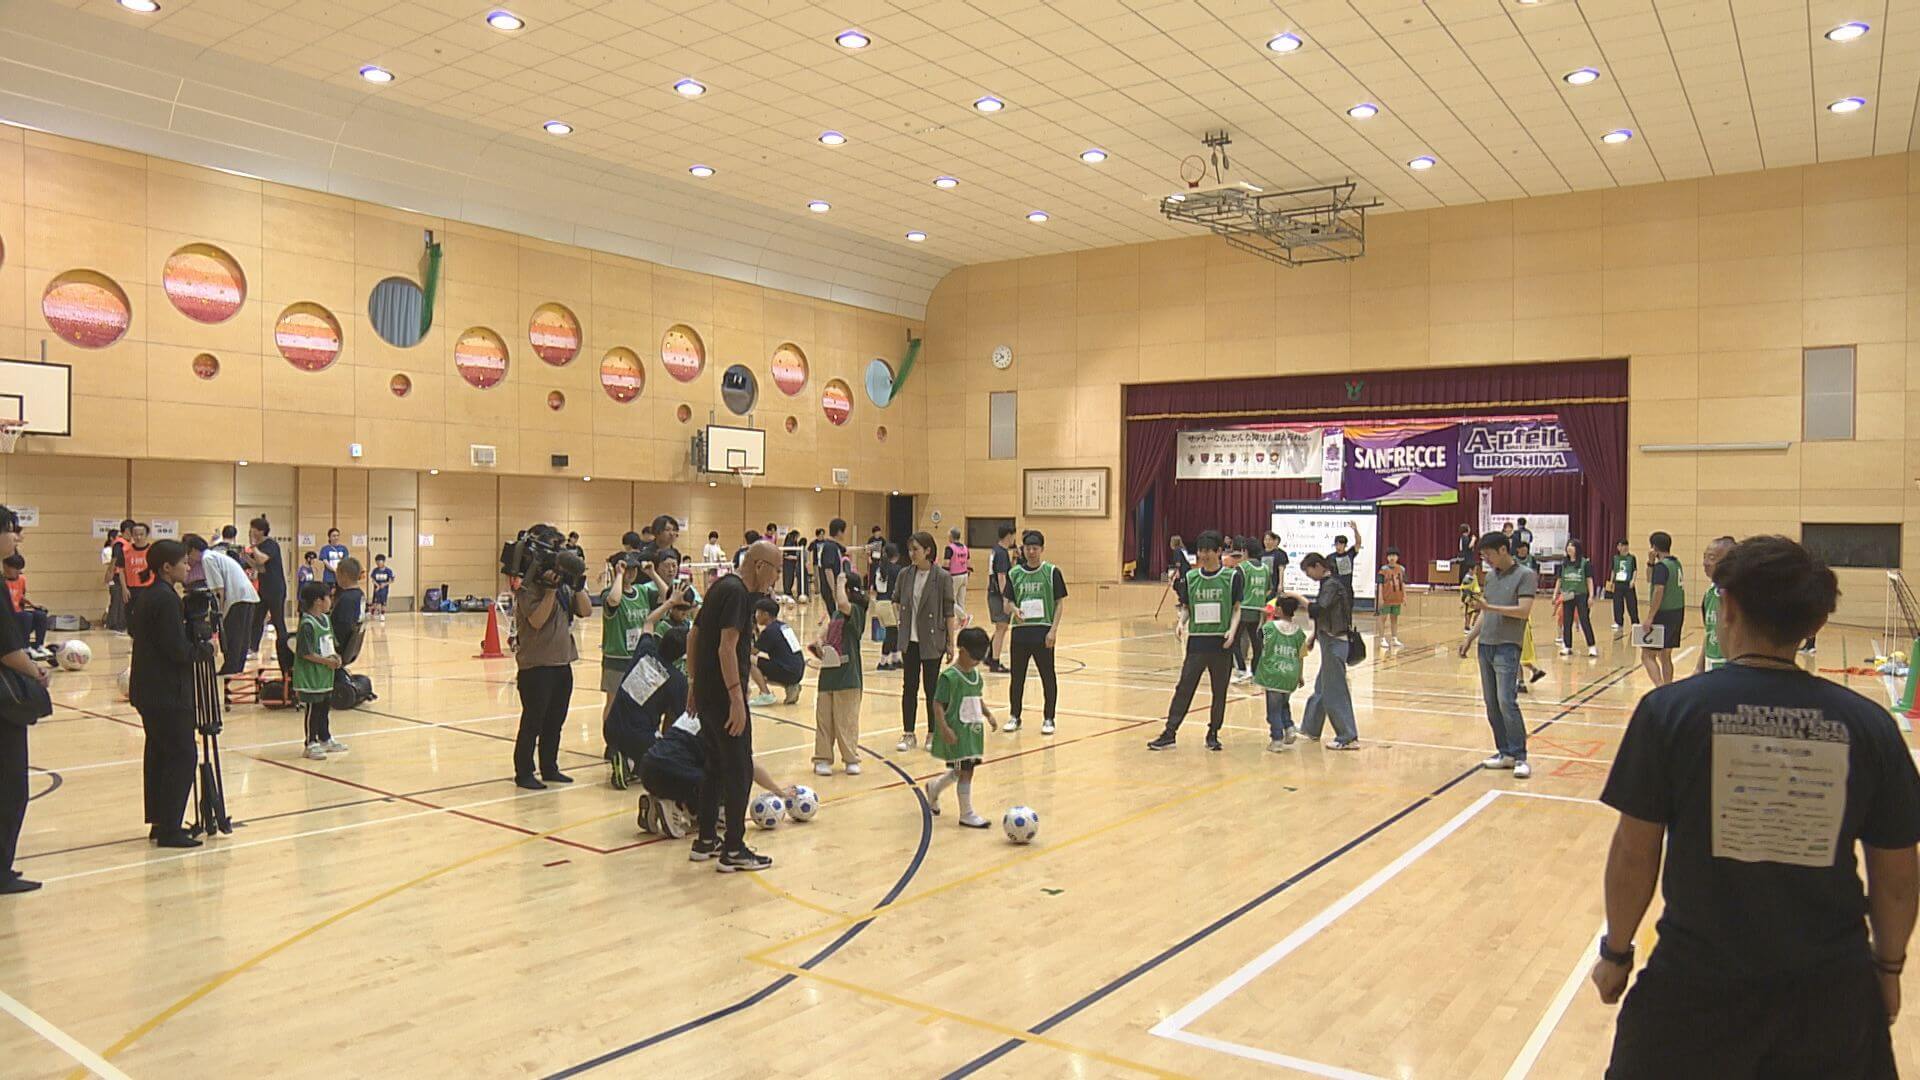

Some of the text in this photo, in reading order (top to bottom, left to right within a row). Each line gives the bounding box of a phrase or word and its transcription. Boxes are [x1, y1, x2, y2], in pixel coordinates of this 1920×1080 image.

[1354, 446, 1447, 468] SANFRECCE
[1474, 452, 1567, 468] HIROSHIMA
[1195, 588, 1222, 601] HIFF
